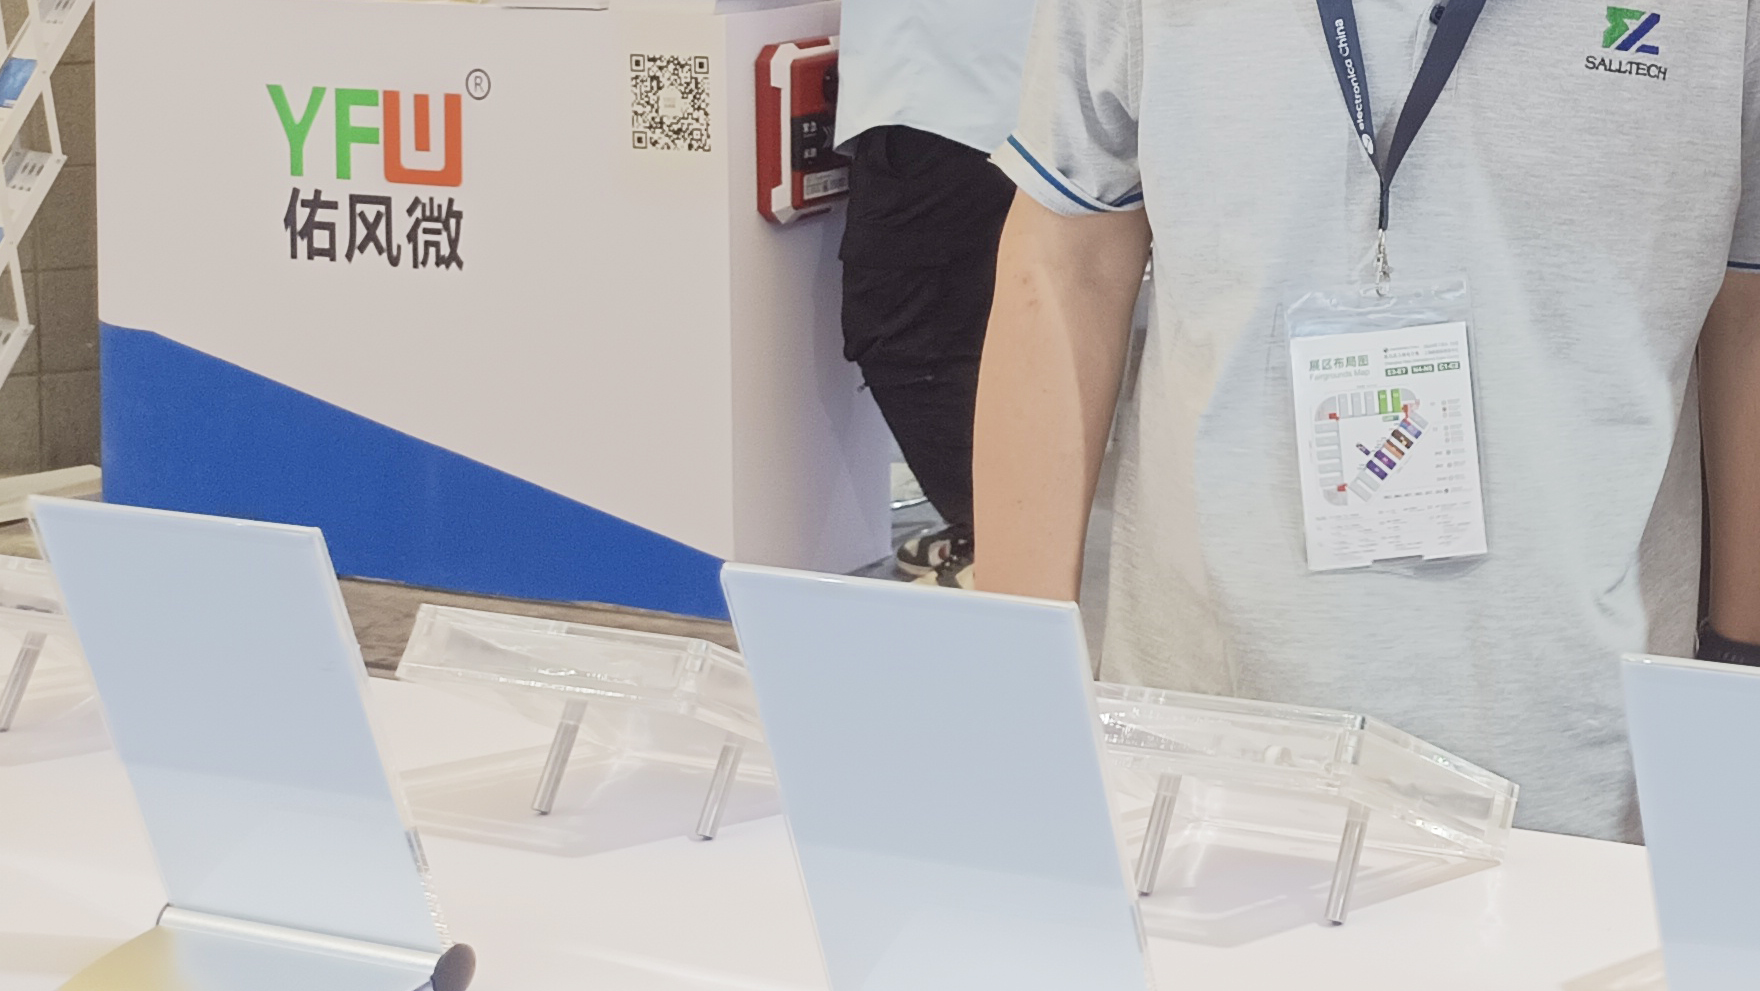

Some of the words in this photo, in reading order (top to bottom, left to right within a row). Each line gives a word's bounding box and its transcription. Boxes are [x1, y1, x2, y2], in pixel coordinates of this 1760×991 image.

[1333, 18, 1351, 58] China
[1342, 58, 1365, 131] electronica
[1584, 55, 1668, 81] SALLTECH
[283, 186, 465, 272] 佑风微
